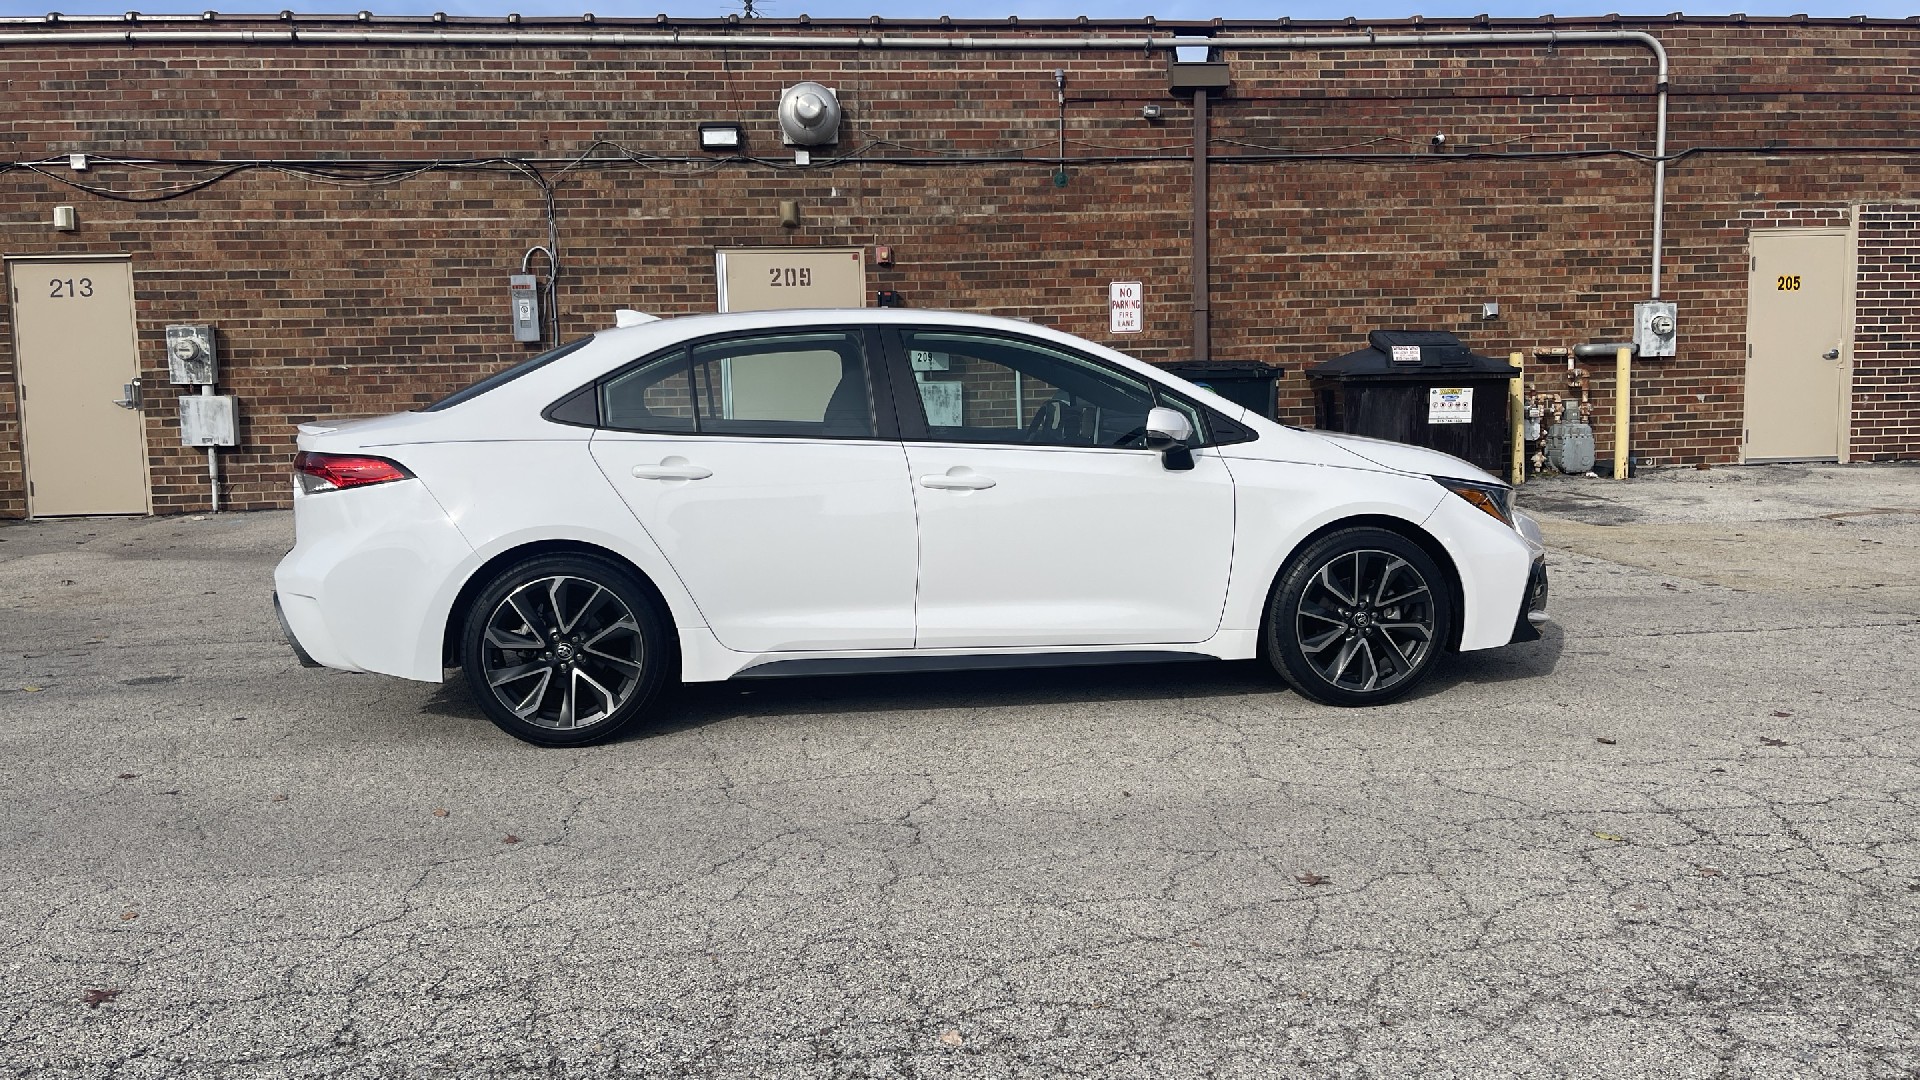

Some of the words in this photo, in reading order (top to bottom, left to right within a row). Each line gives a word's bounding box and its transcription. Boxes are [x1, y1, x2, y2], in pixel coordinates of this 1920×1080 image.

[769, 267, 812, 287] 209
[49, 277, 94, 298] 213
[1777, 275, 1801, 291] 205
[1119, 287, 1132, 298] NO
[1112, 299, 1140, 310] PARKING
[1118, 311, 1133, 319] FIRE
[1117, 319, 1135, 327] LANE
[917, 352, 933, 363] 209
